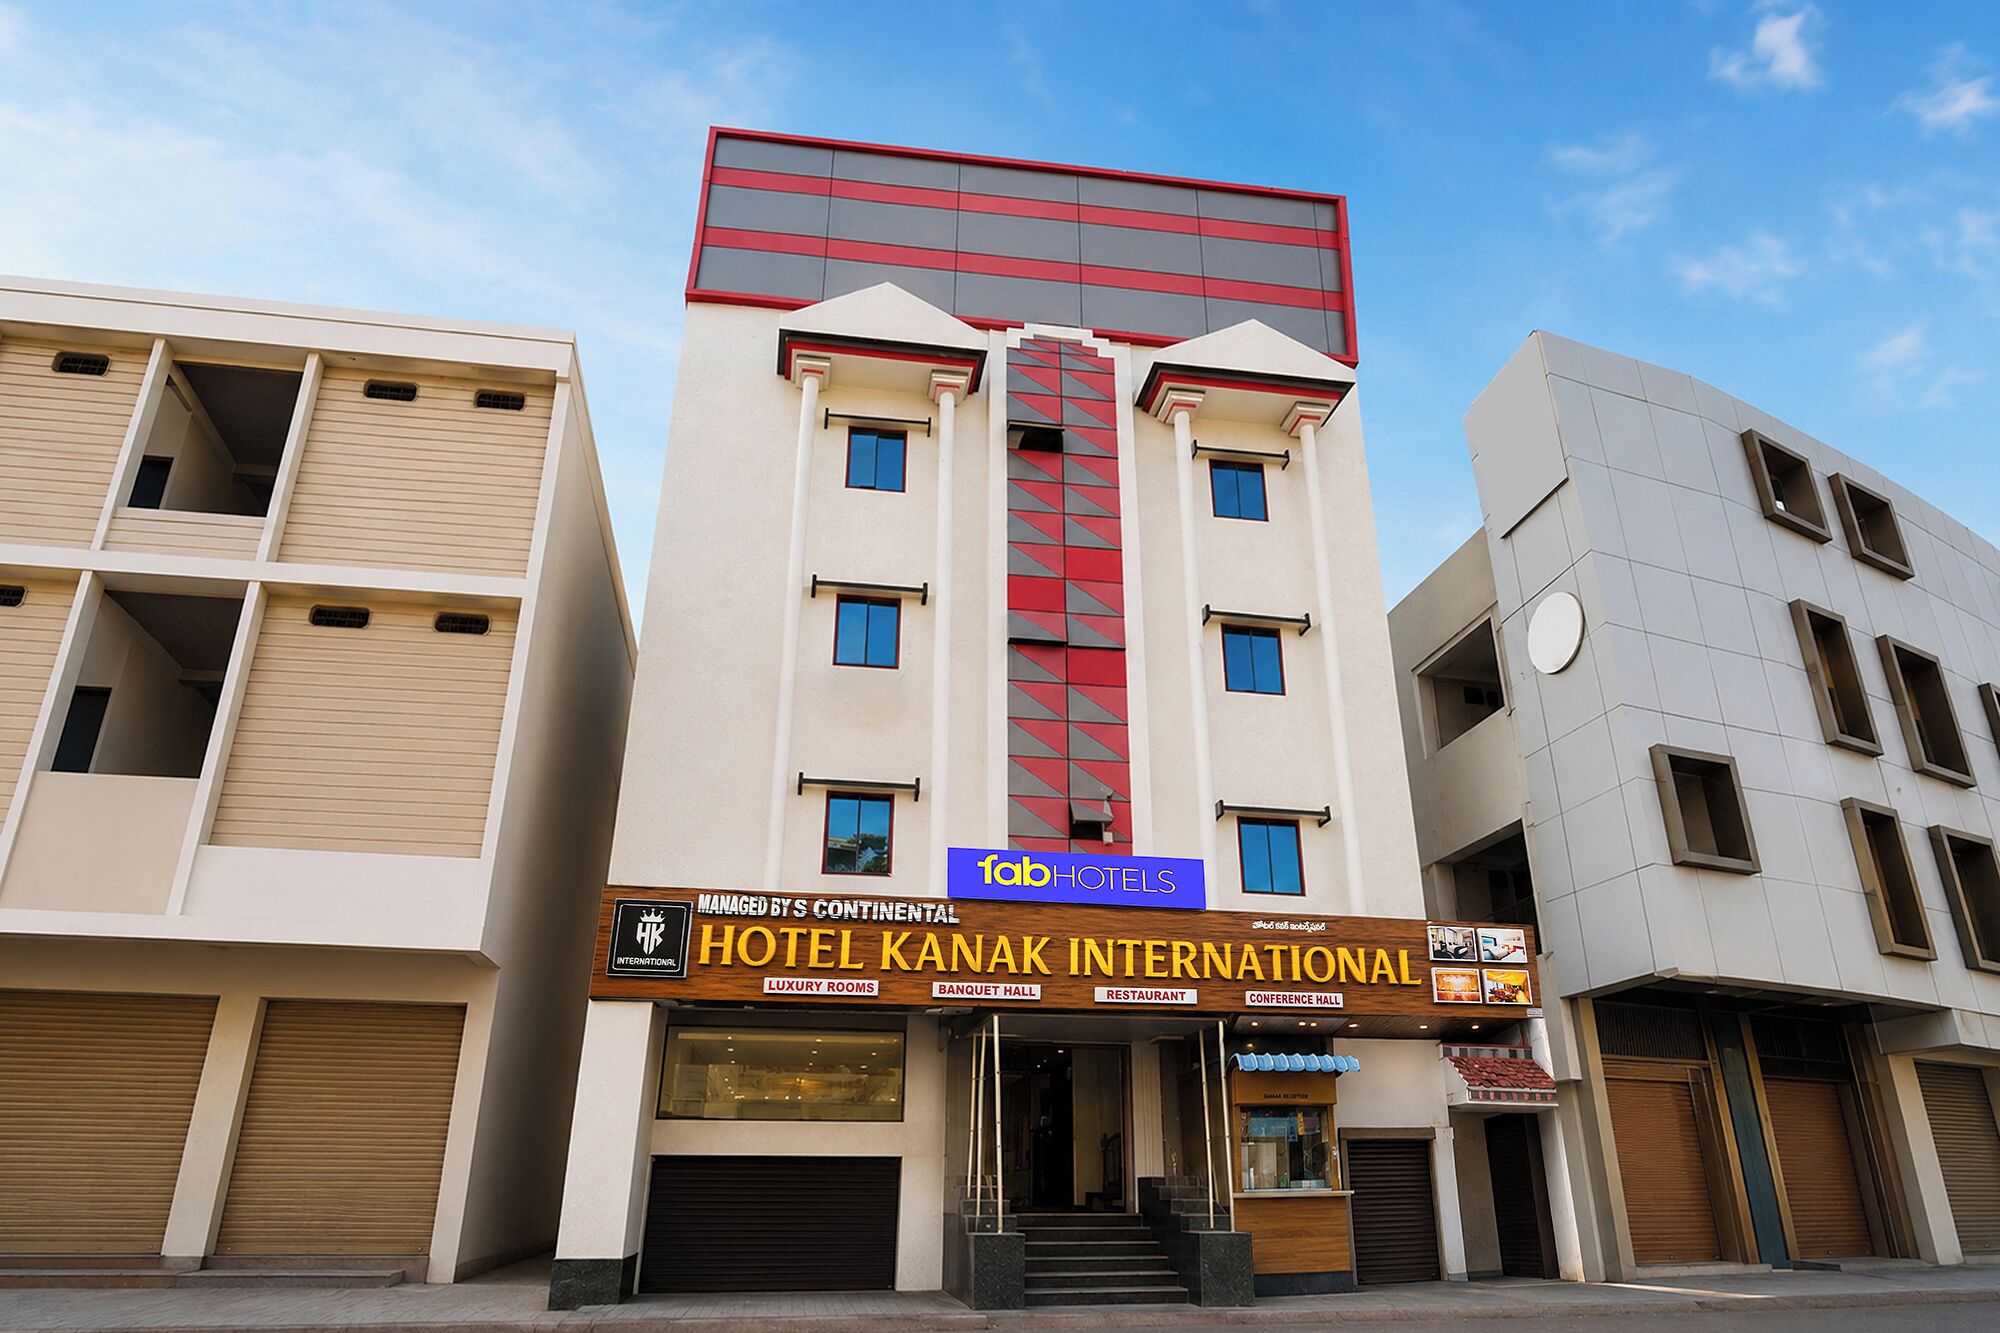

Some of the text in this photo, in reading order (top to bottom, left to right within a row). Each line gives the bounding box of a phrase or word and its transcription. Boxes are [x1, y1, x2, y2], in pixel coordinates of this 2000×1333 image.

[698, 893, 960, 924] MANAGED BY S CONTINENTAL
[698, 924, 1422, 985] HOTEL KANAK INTERNATIONAL
[617, 956, 676, 967] INTERNATIONAL
[768, 980, 875, 993] LUXURY ROOMS
[938, 984, 1036, 997] BANQUET HALL
[1106, 989, 1187, 1001] RESTAURANT
[1249, 993, 1340, 1005] CONFERENCE HALL
